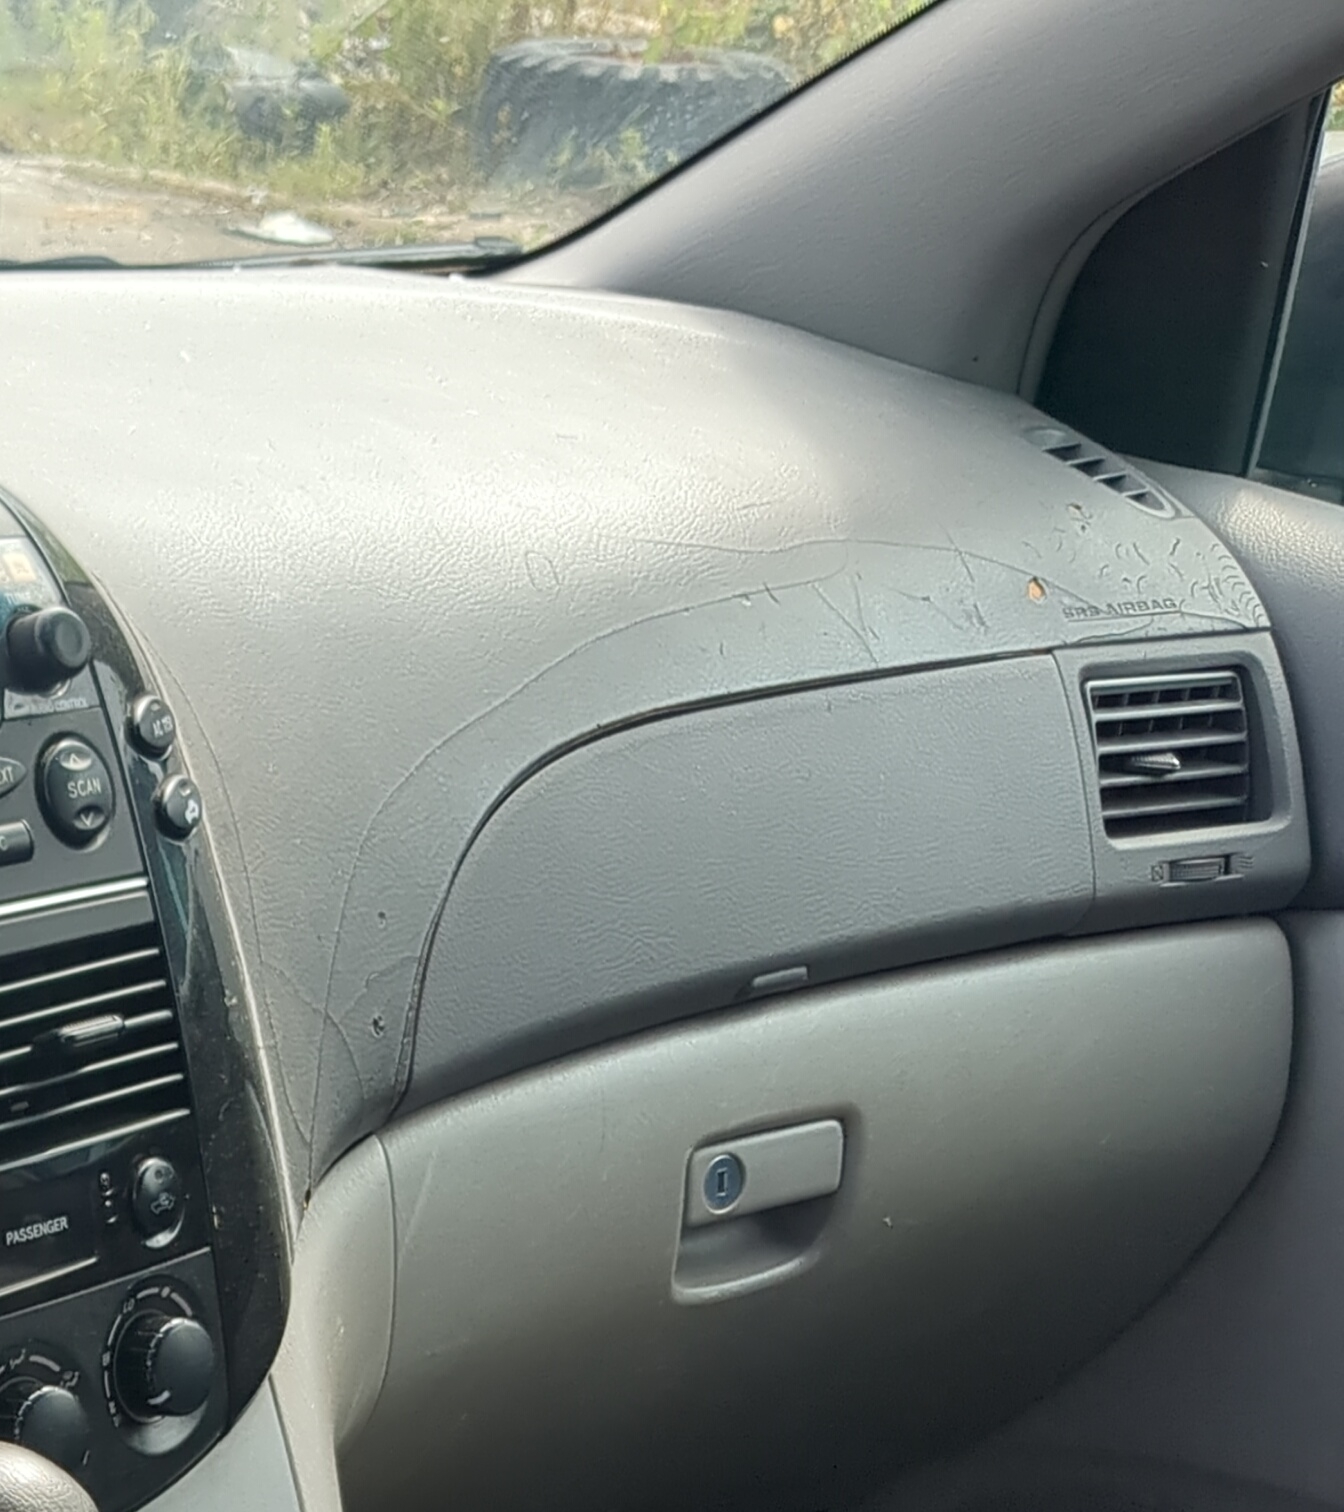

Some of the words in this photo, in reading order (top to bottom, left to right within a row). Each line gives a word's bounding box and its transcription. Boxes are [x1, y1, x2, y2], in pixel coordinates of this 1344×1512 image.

[1105, 598, 1177, 616] AIRBAG
[67, 777, 102, 799] SCAN
[5, 1215, 69, 1246] PASSENGER
